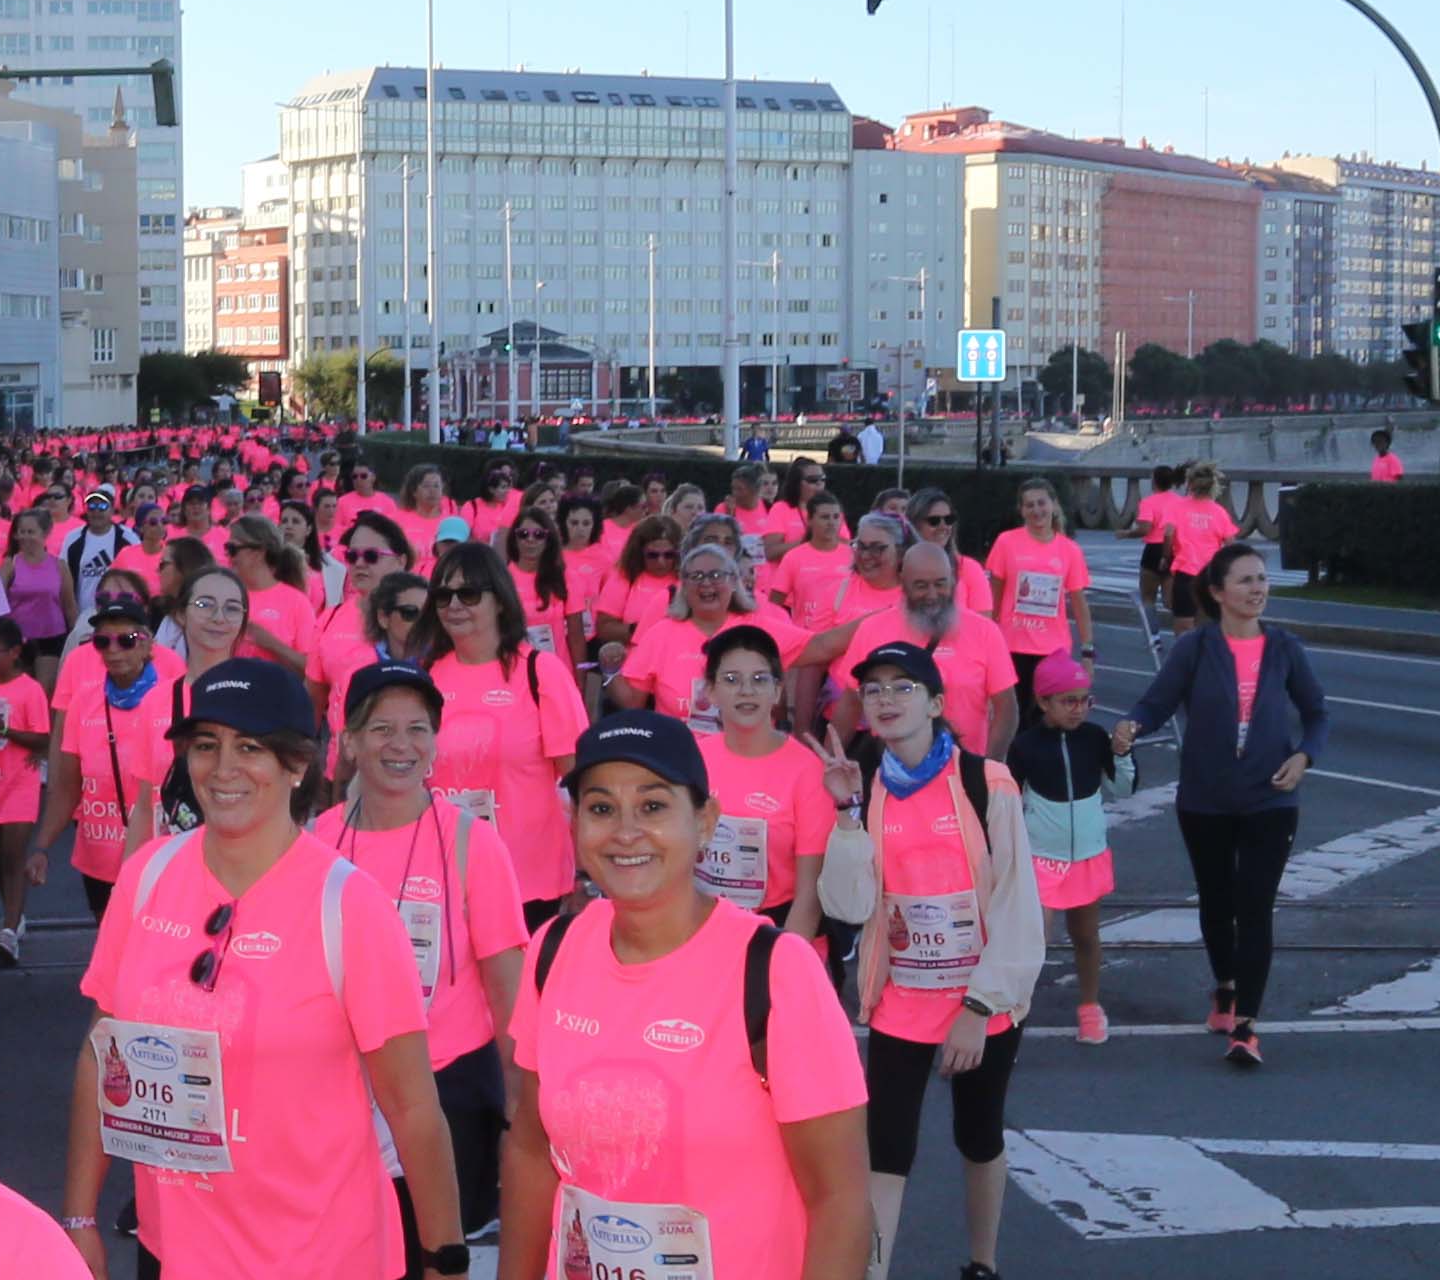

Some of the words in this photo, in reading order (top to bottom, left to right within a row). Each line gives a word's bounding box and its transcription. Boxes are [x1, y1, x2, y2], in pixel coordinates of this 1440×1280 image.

[705, 848, 731, 864] 016
[912, 932, 945, 946] 016
[554, 1010, 600, 1037] YSHO
[135, 1079, 174, 1104] 016
[142, 1107, 167, 1123] 2171
[153, 1127, 162, 1136] LA
[164, 1129, 190, 1140] MUJER
[591, 1226, 646, 1245] ASTURIANA
[658, 1226, 694, 1235] SUMA
